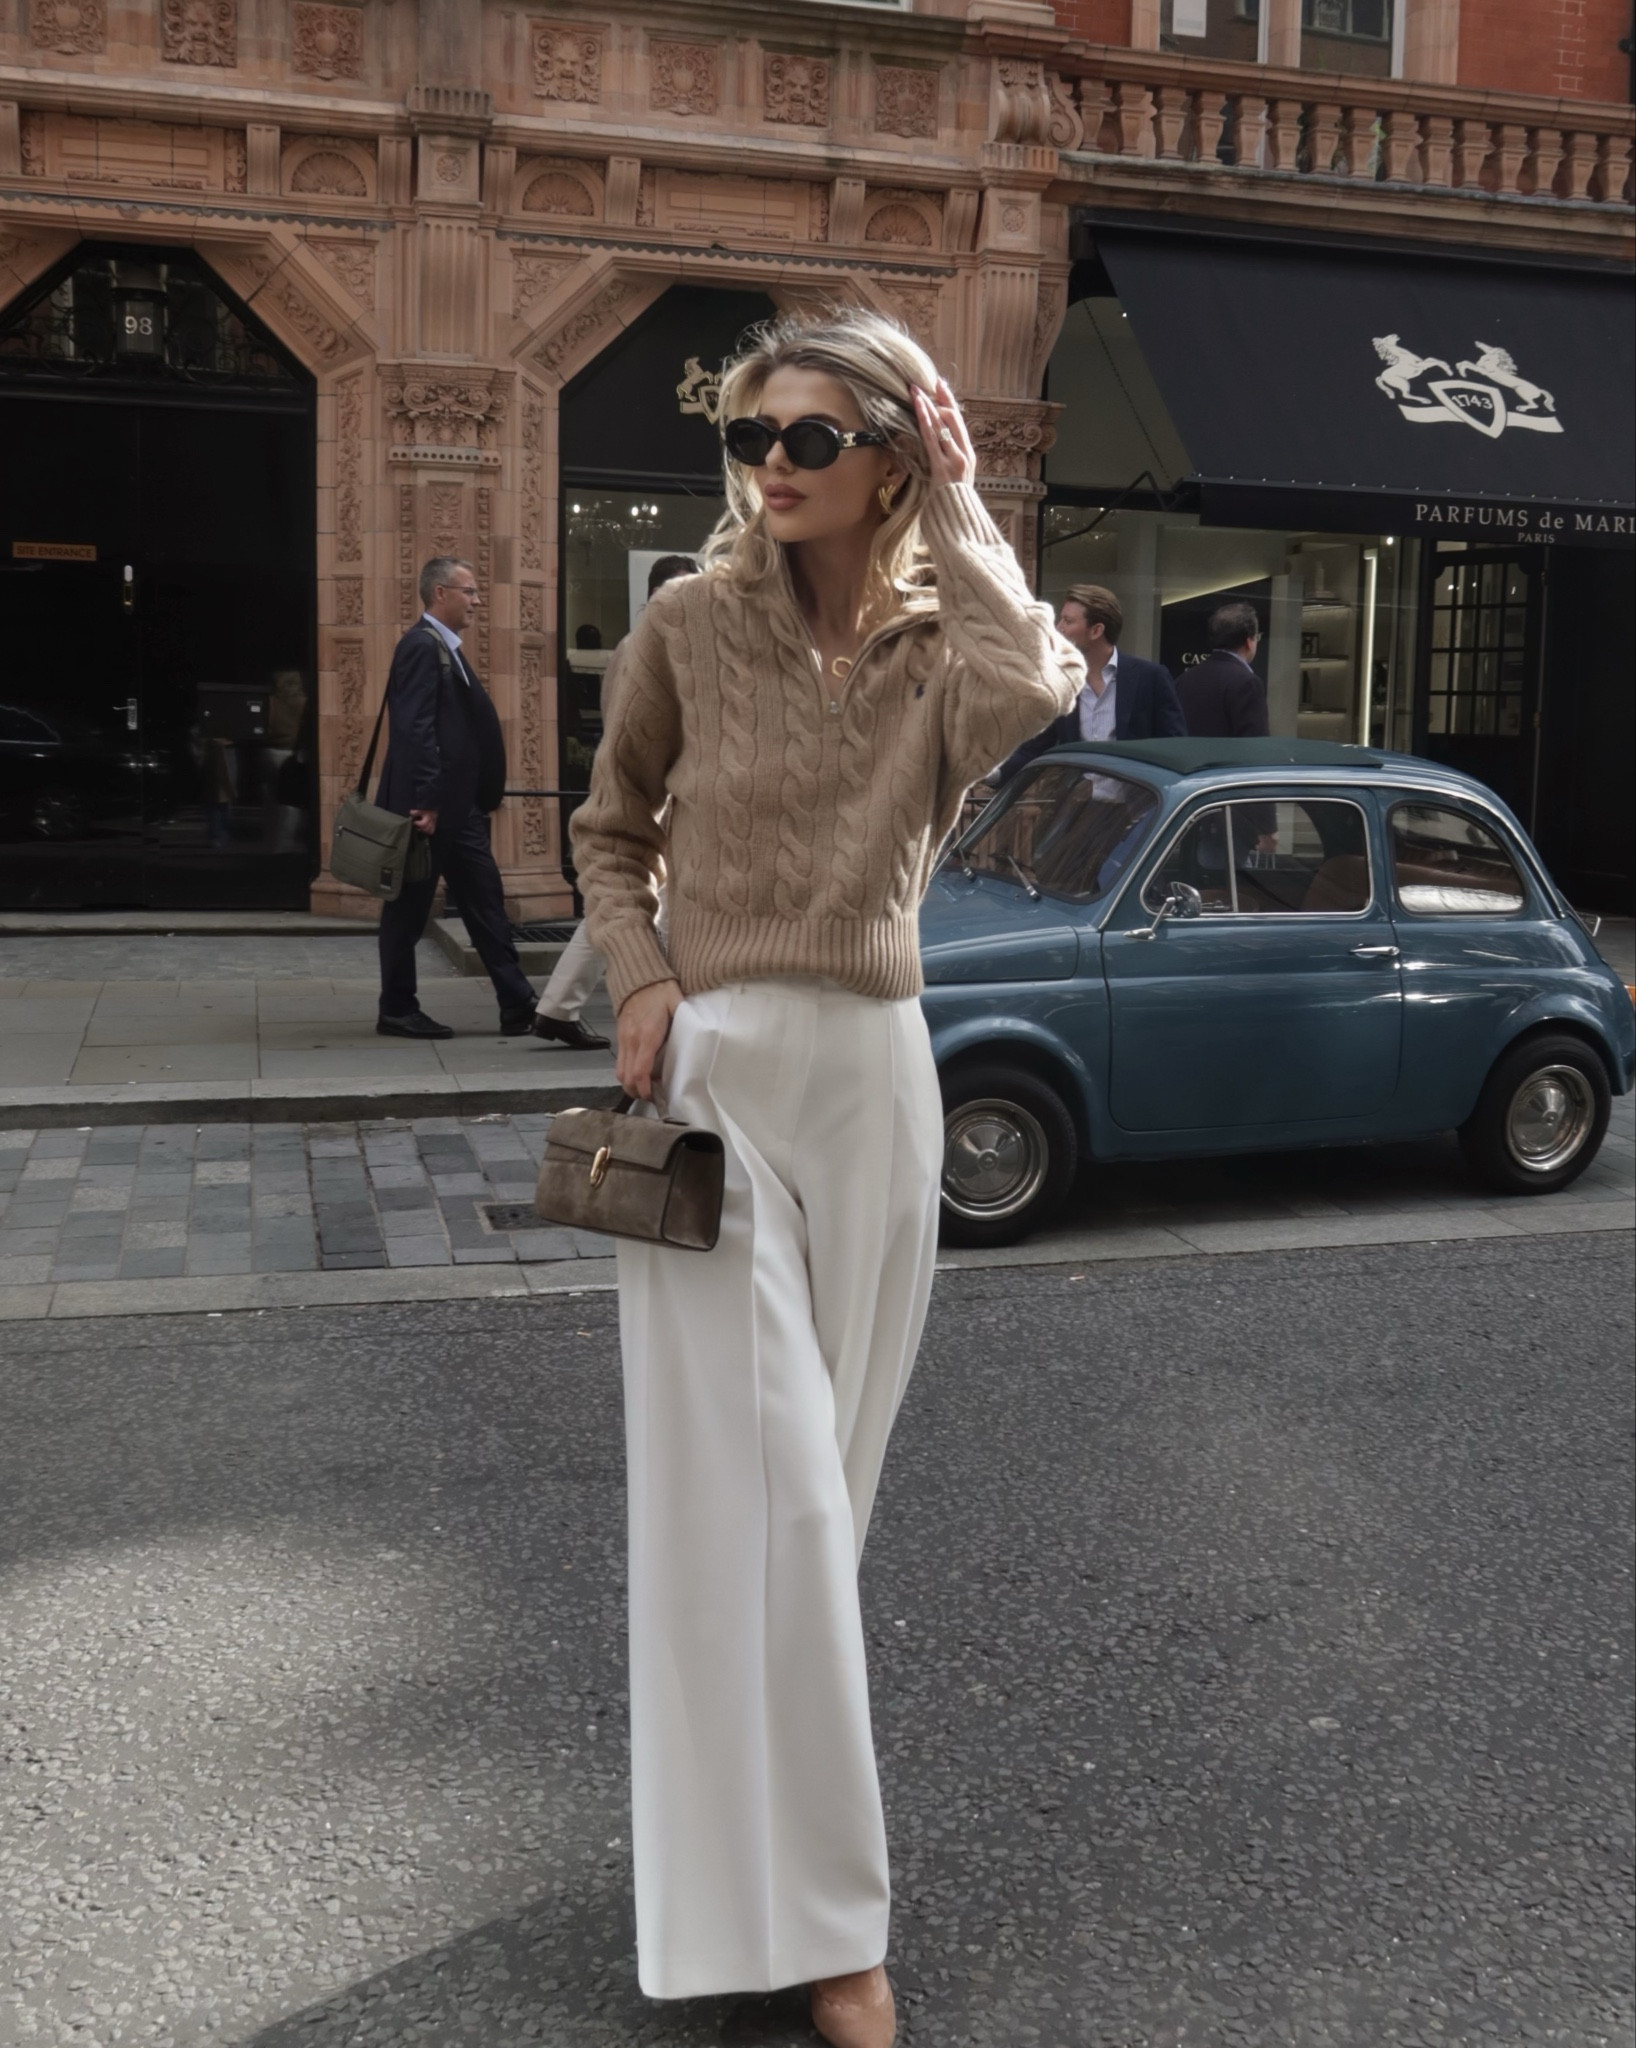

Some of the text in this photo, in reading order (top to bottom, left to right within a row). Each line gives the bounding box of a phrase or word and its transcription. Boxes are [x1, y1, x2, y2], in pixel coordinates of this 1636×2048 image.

[124, 315, 153, 335] 98
[1451, 394, 1493, 410] 1743
[1415, 503, 1528, 527] PARFUMS
[1539, 511, 1564, 529] de
[1517, 532, 1555, 544] PARIS
[17, 545, 93, 559] SITE ENTRANCE
[1181, 652, 1212, 665] CAS
